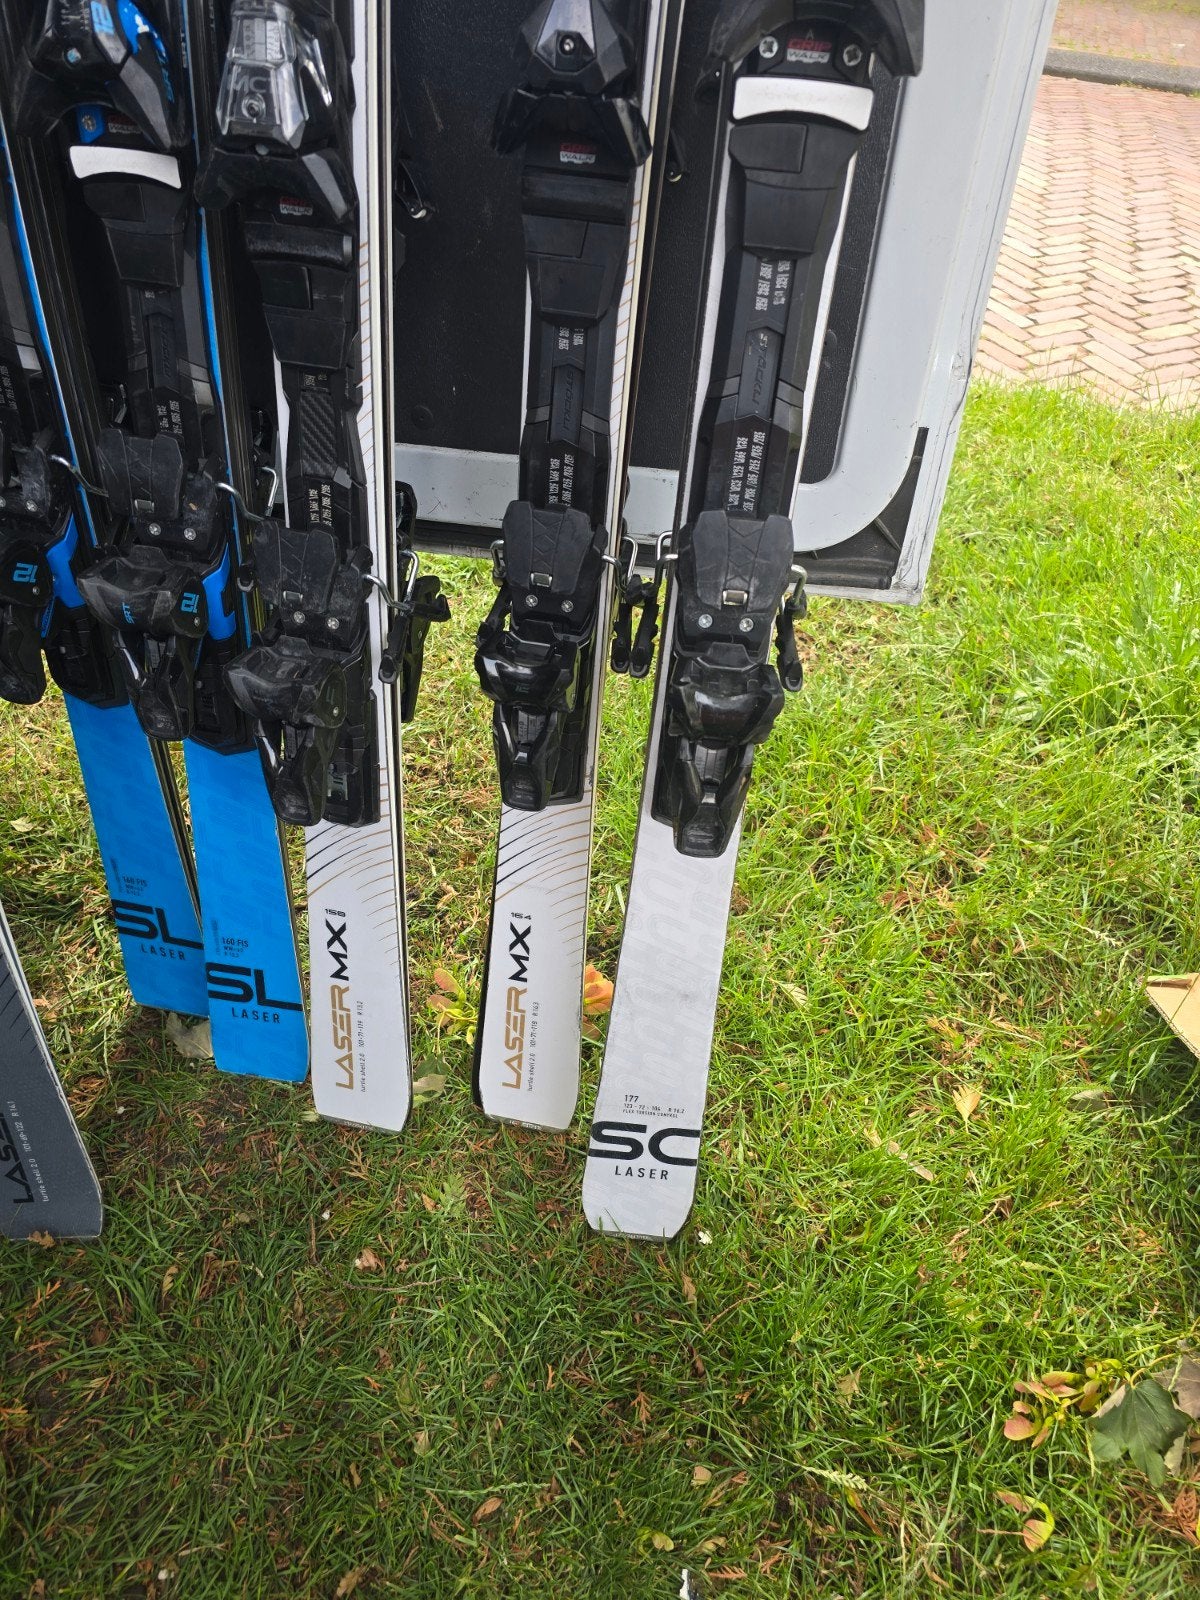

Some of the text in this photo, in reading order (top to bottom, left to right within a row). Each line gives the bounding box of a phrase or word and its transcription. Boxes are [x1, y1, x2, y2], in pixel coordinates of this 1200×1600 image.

[787, 50, 829, 61] WALK
[561, 152, 595, 162] WALK
[111, 899, 204, 950] SL
[222, 937, 249, 948] 160 FIS
[140, 944, 186, 960] LASER
[205, 962, 303, 1012] SL
[325, 918, 354, 1090] LASER MX
[501, 921, 531, 1089] LASER MX
[231, 1007, 281, 1023] LASER
[624, 1094, 639, 1103] 177
[588, 1121, 701, 1166] SC
[33, 1169, 43, 1184] shell
[614, 1165, 669, 1180] LASER
[39, 1185, 49, 1202] turtle
